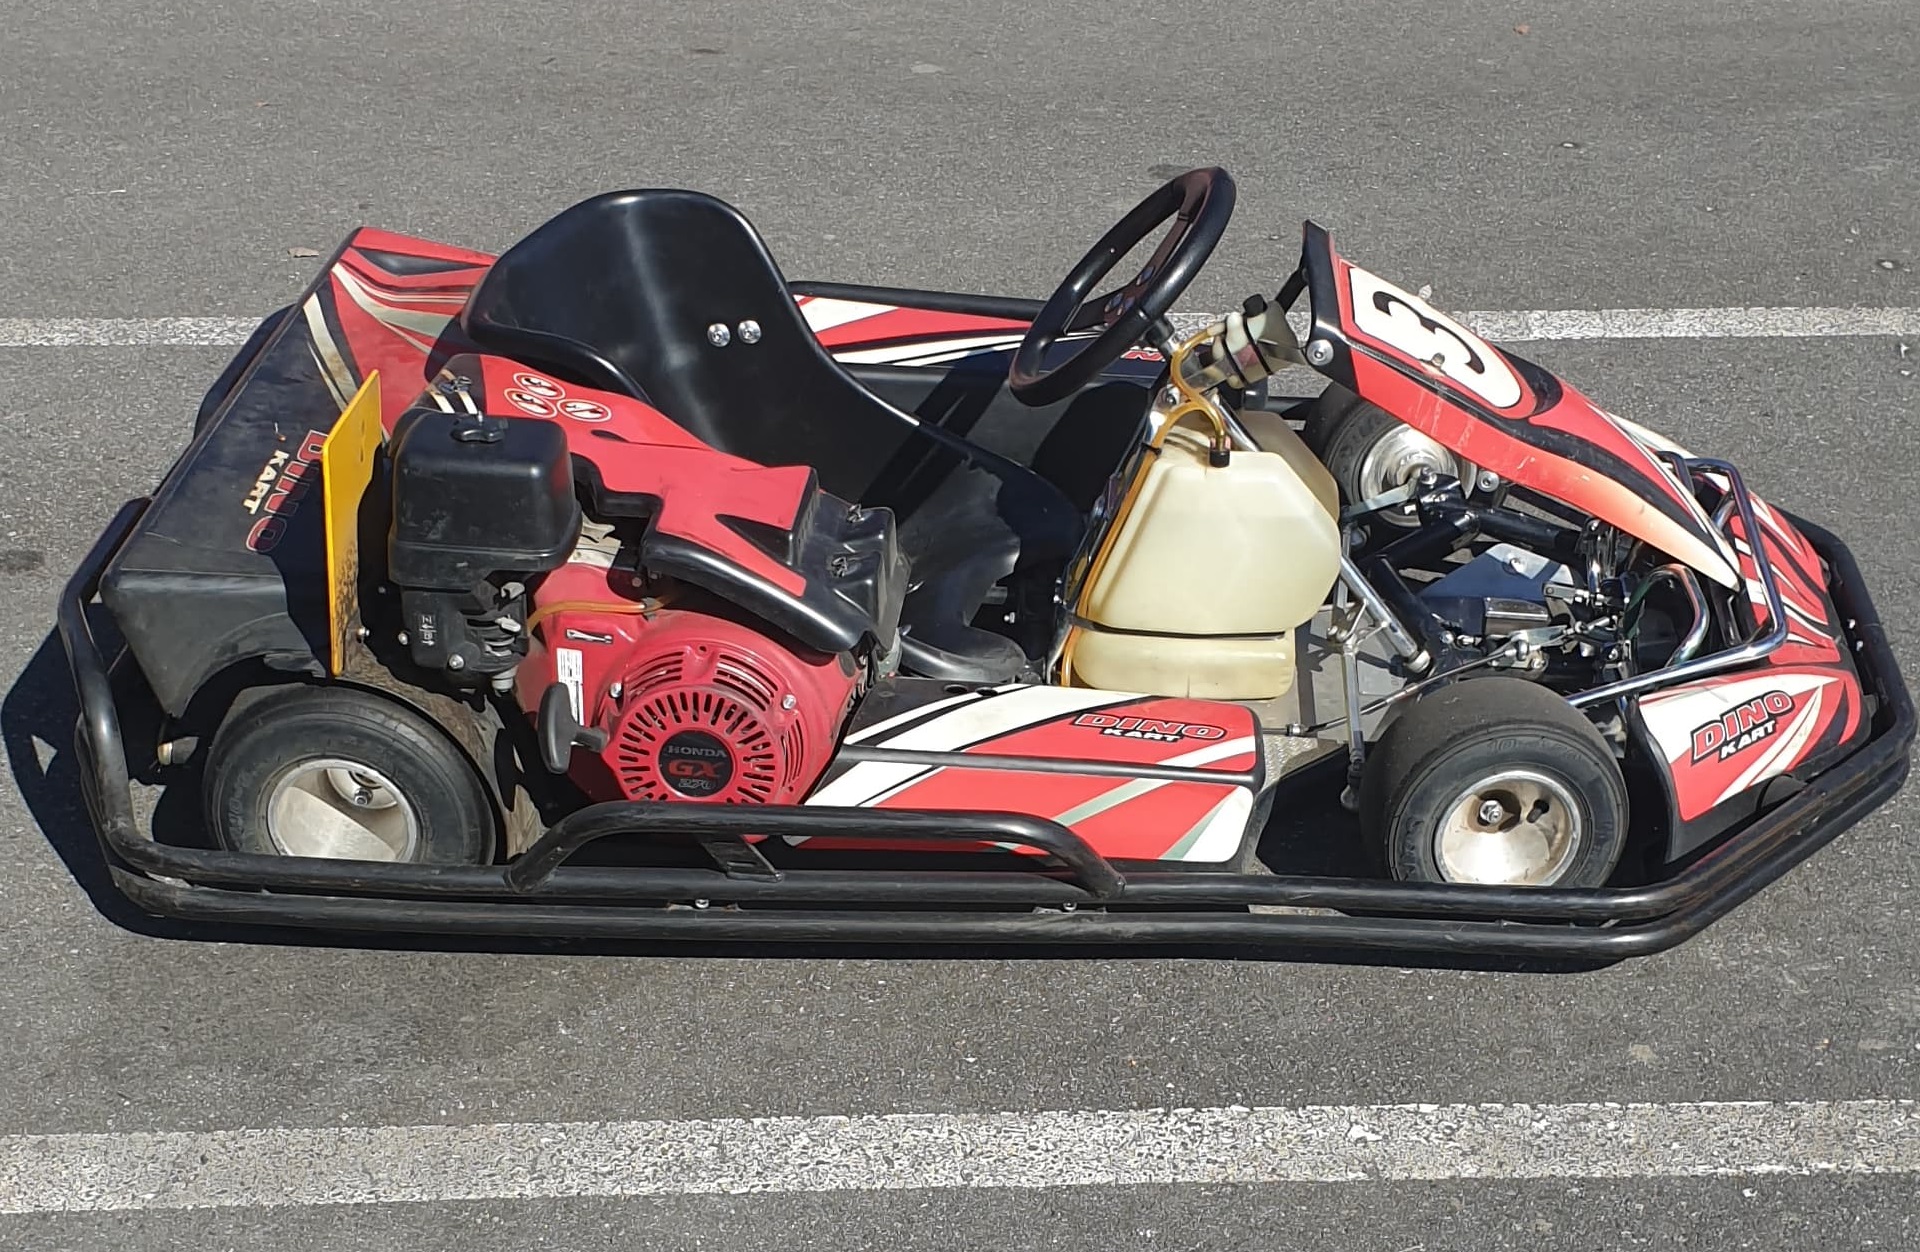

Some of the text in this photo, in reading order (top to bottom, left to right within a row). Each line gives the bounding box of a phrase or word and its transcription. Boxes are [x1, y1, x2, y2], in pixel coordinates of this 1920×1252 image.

[1373, 291, 1485, 374] 3
[243, 450, 289, 514] KART
[246, 429, 329, 552] DINO
[1073, 713, 1226, 740] DINO
[1103, 728, 1181, 742] KART
[1691, 690, 1795, 763] DINO
[1719, 720, 1776, 759] KART
[668, 745, 728, 757] HONDA
[668, 759, 725, 778] GX
